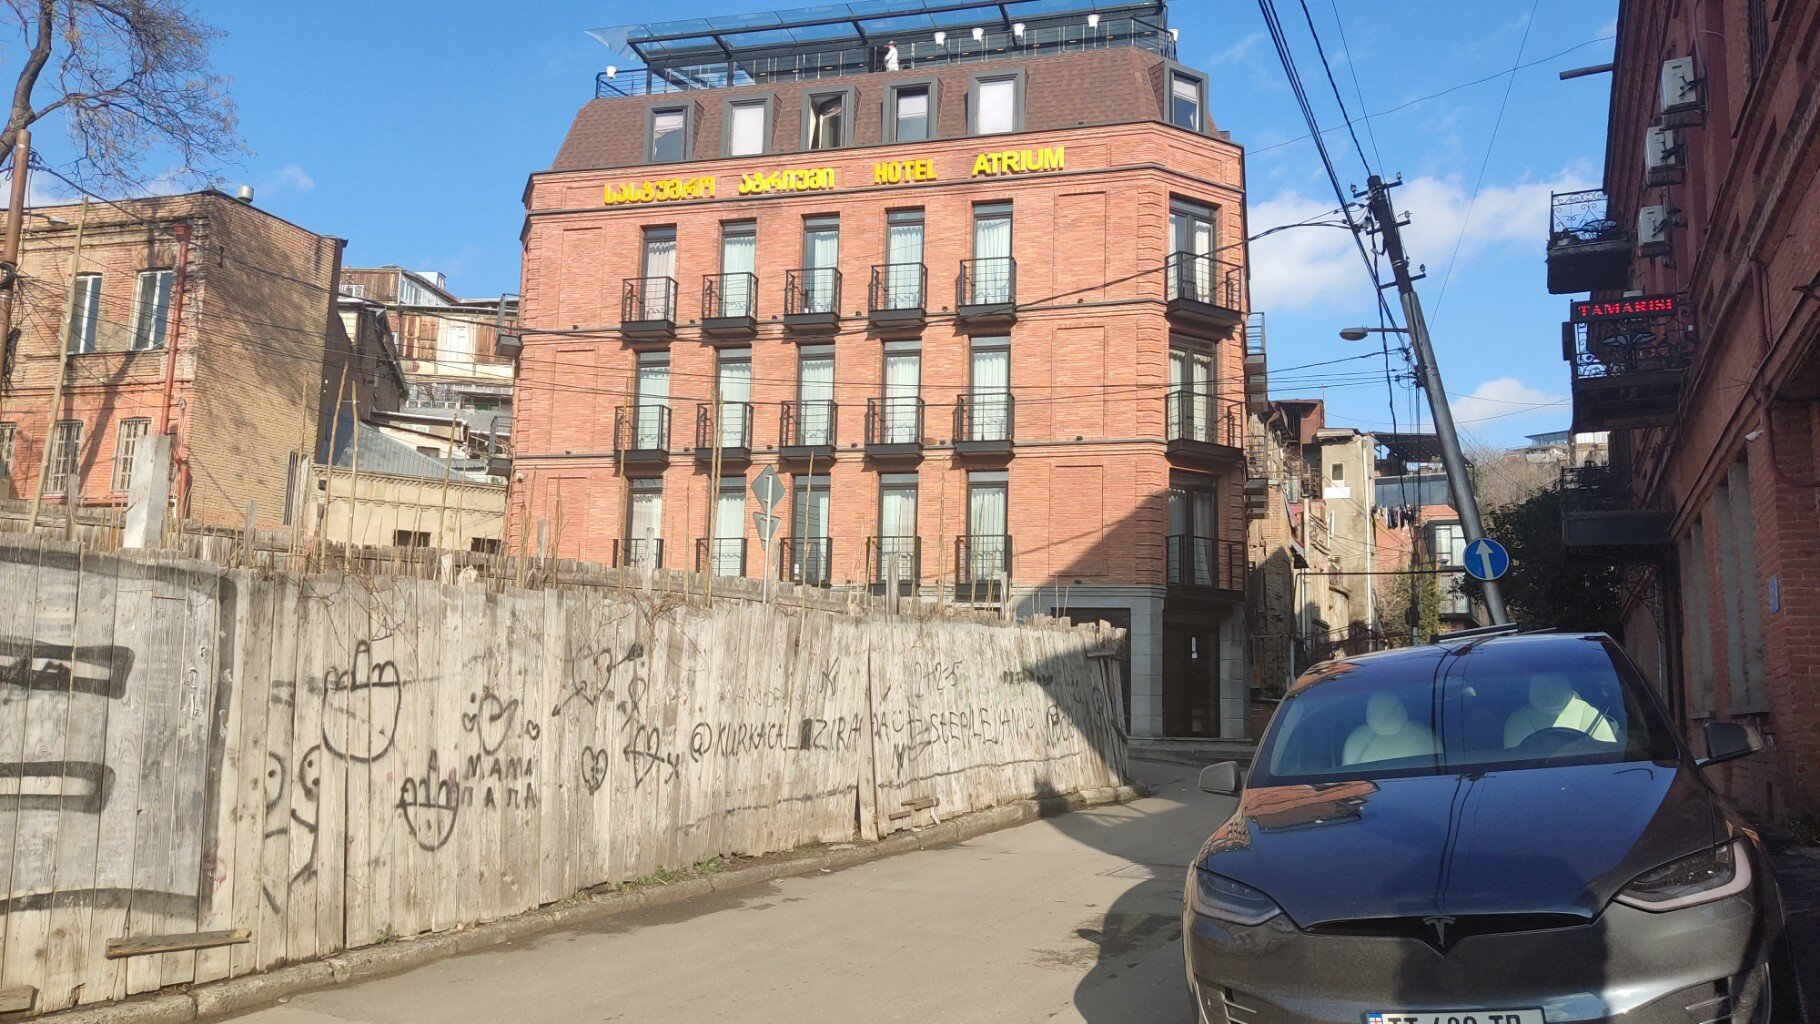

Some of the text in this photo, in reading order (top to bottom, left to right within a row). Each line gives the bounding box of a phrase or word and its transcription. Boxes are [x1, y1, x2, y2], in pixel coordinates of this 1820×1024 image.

[874, 147, 1065, 184] HOTEL ATRIUM
[604, 168, 835, 204] სასტუმრო ატრიუმი
